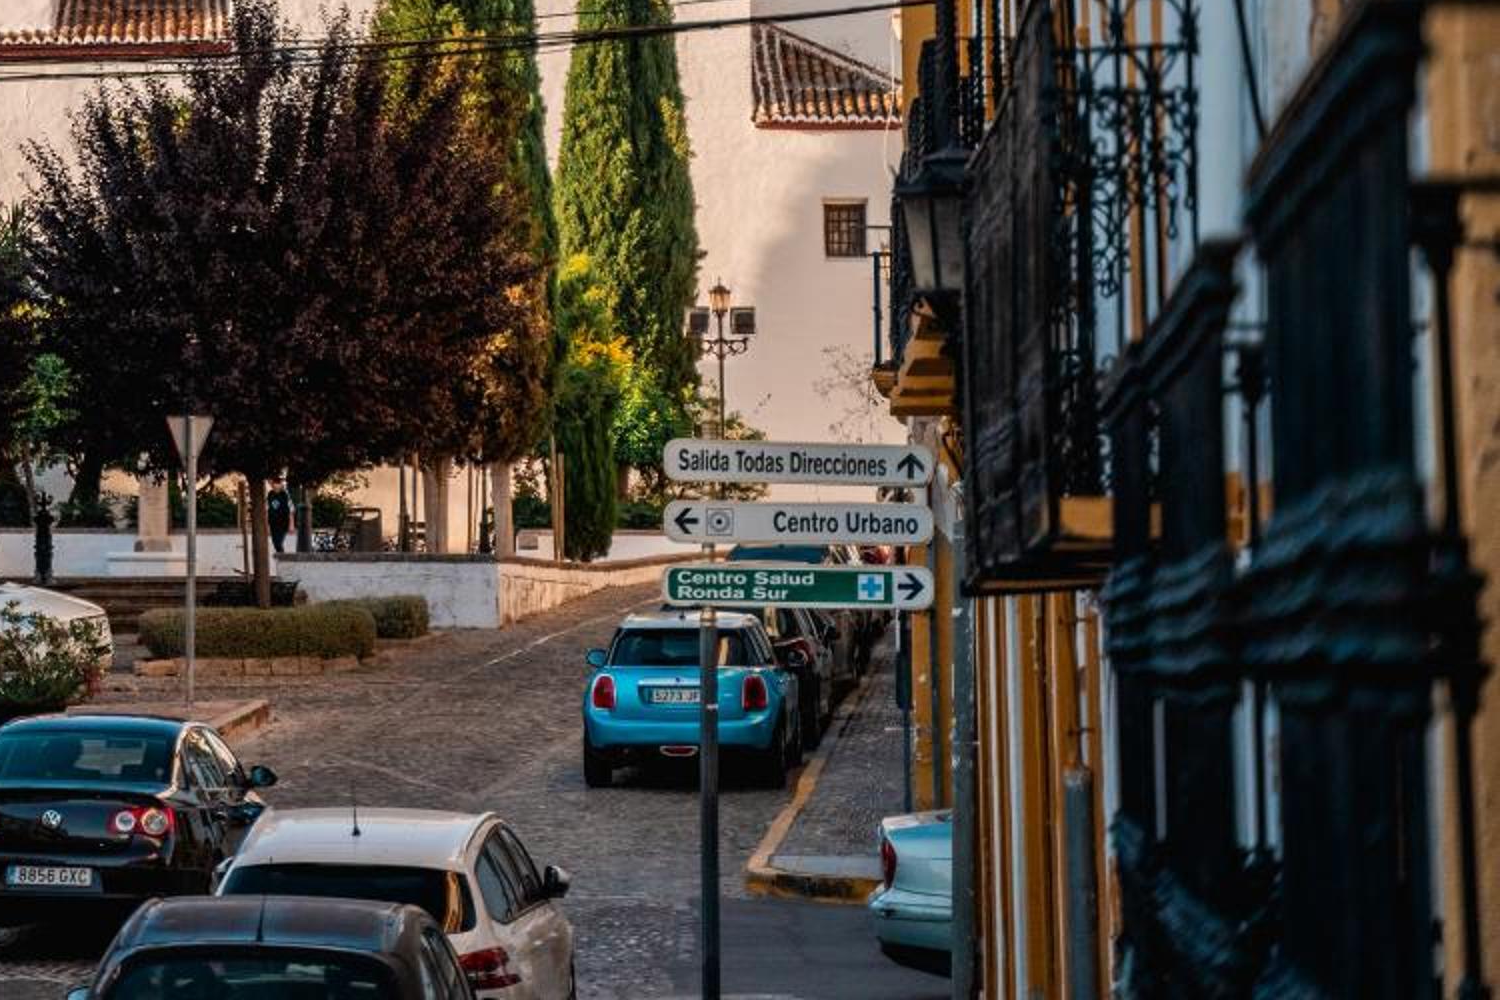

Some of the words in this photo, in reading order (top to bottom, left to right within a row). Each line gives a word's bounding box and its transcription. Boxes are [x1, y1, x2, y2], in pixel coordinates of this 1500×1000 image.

[678, 449, 729, 473] Salida
[735, 450, 784, 474] Todas
[789, 452, 887, 476] Direcciones
[773, 511, 838, 533] Centro
[846, 512, 918, 535] Urbano
[677, 571, 747, 584] Centro
[754, 572, 815, 585] Salud
[677, 586, 745, 599] Ronda
[753, 587, 789, 600] Sur
[59, 868, 87, 883] GXC
